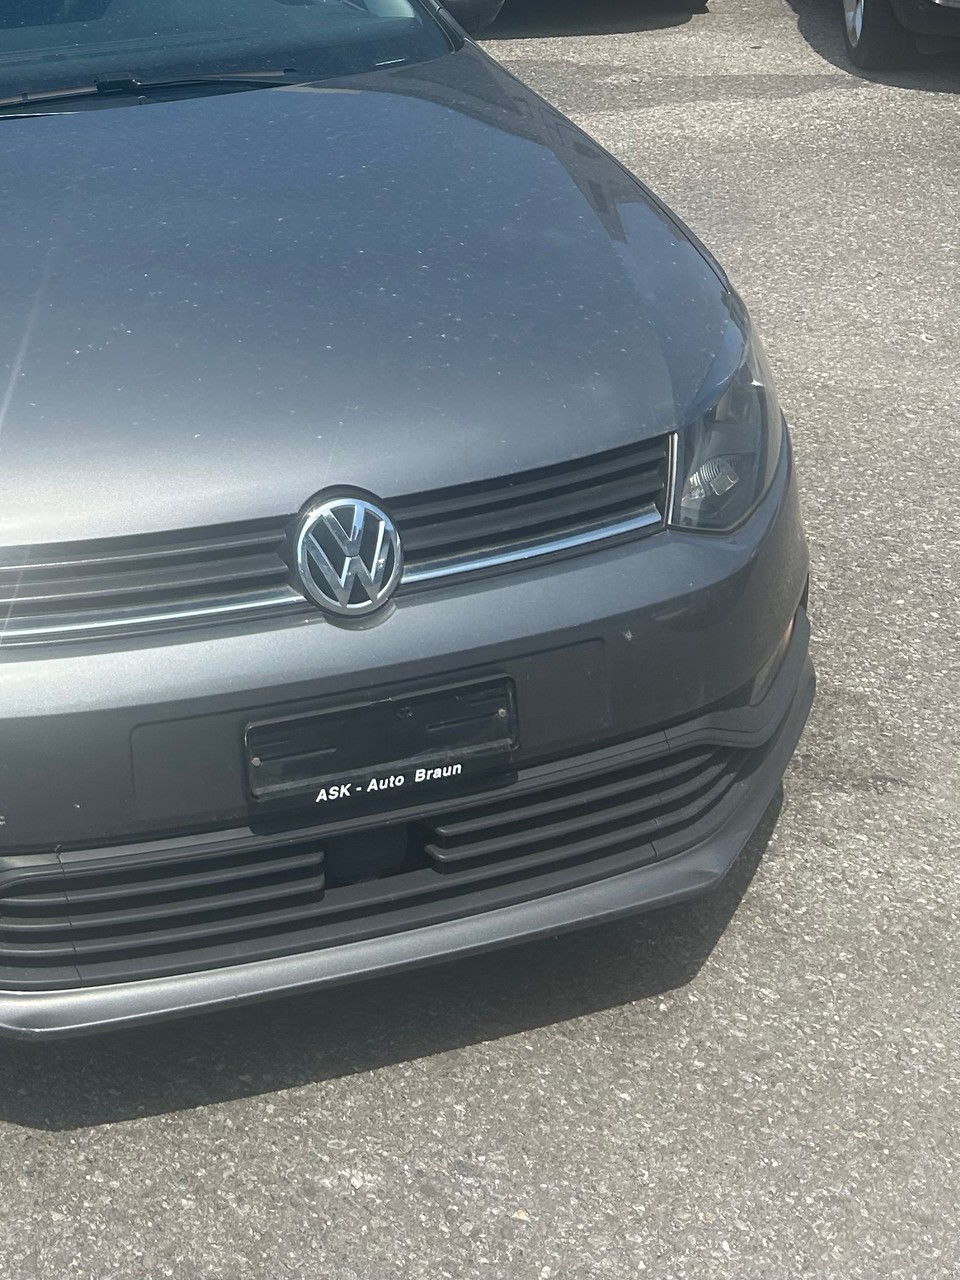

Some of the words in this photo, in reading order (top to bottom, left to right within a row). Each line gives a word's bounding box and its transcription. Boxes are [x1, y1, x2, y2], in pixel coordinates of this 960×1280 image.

[298, 499, 401, 614] VW
[315, 783, 352, 803] ASK
[366, 773, 405, 793] Auto
[414, 762, 463, 783] Braun
